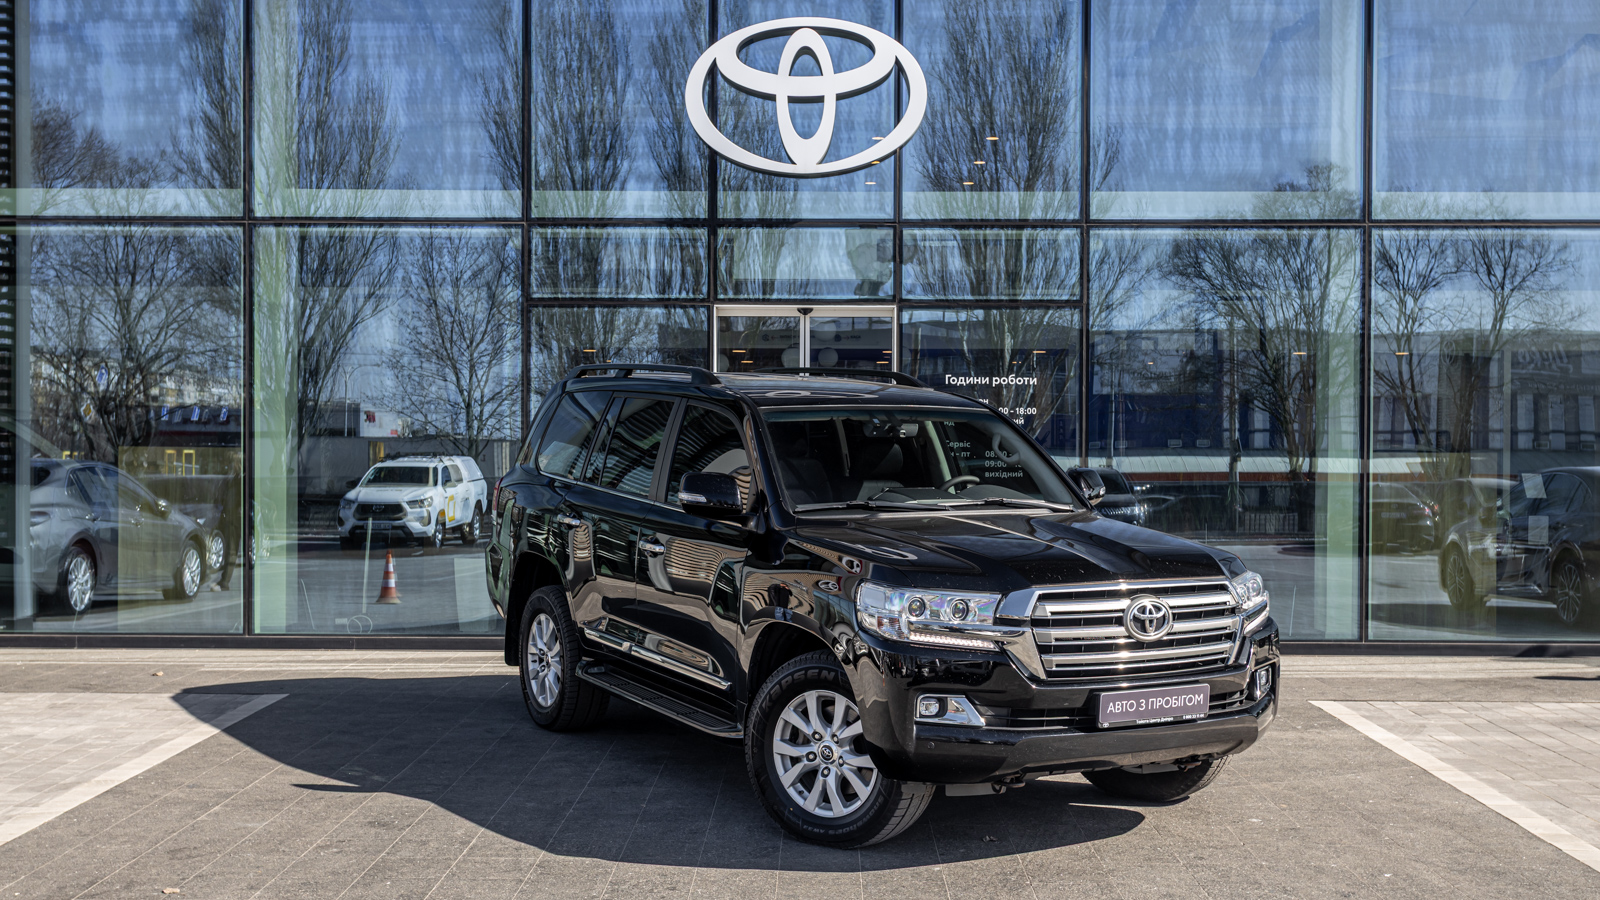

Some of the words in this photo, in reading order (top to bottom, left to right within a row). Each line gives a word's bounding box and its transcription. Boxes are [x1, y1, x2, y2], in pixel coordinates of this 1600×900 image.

[945, 374, 990, 386] Години
[992, 374, 1038, 387] роботи
[1107, 700, 1136, 713] АВТО
[1148, 694, 1204, 710] ПРОБІГОМ
